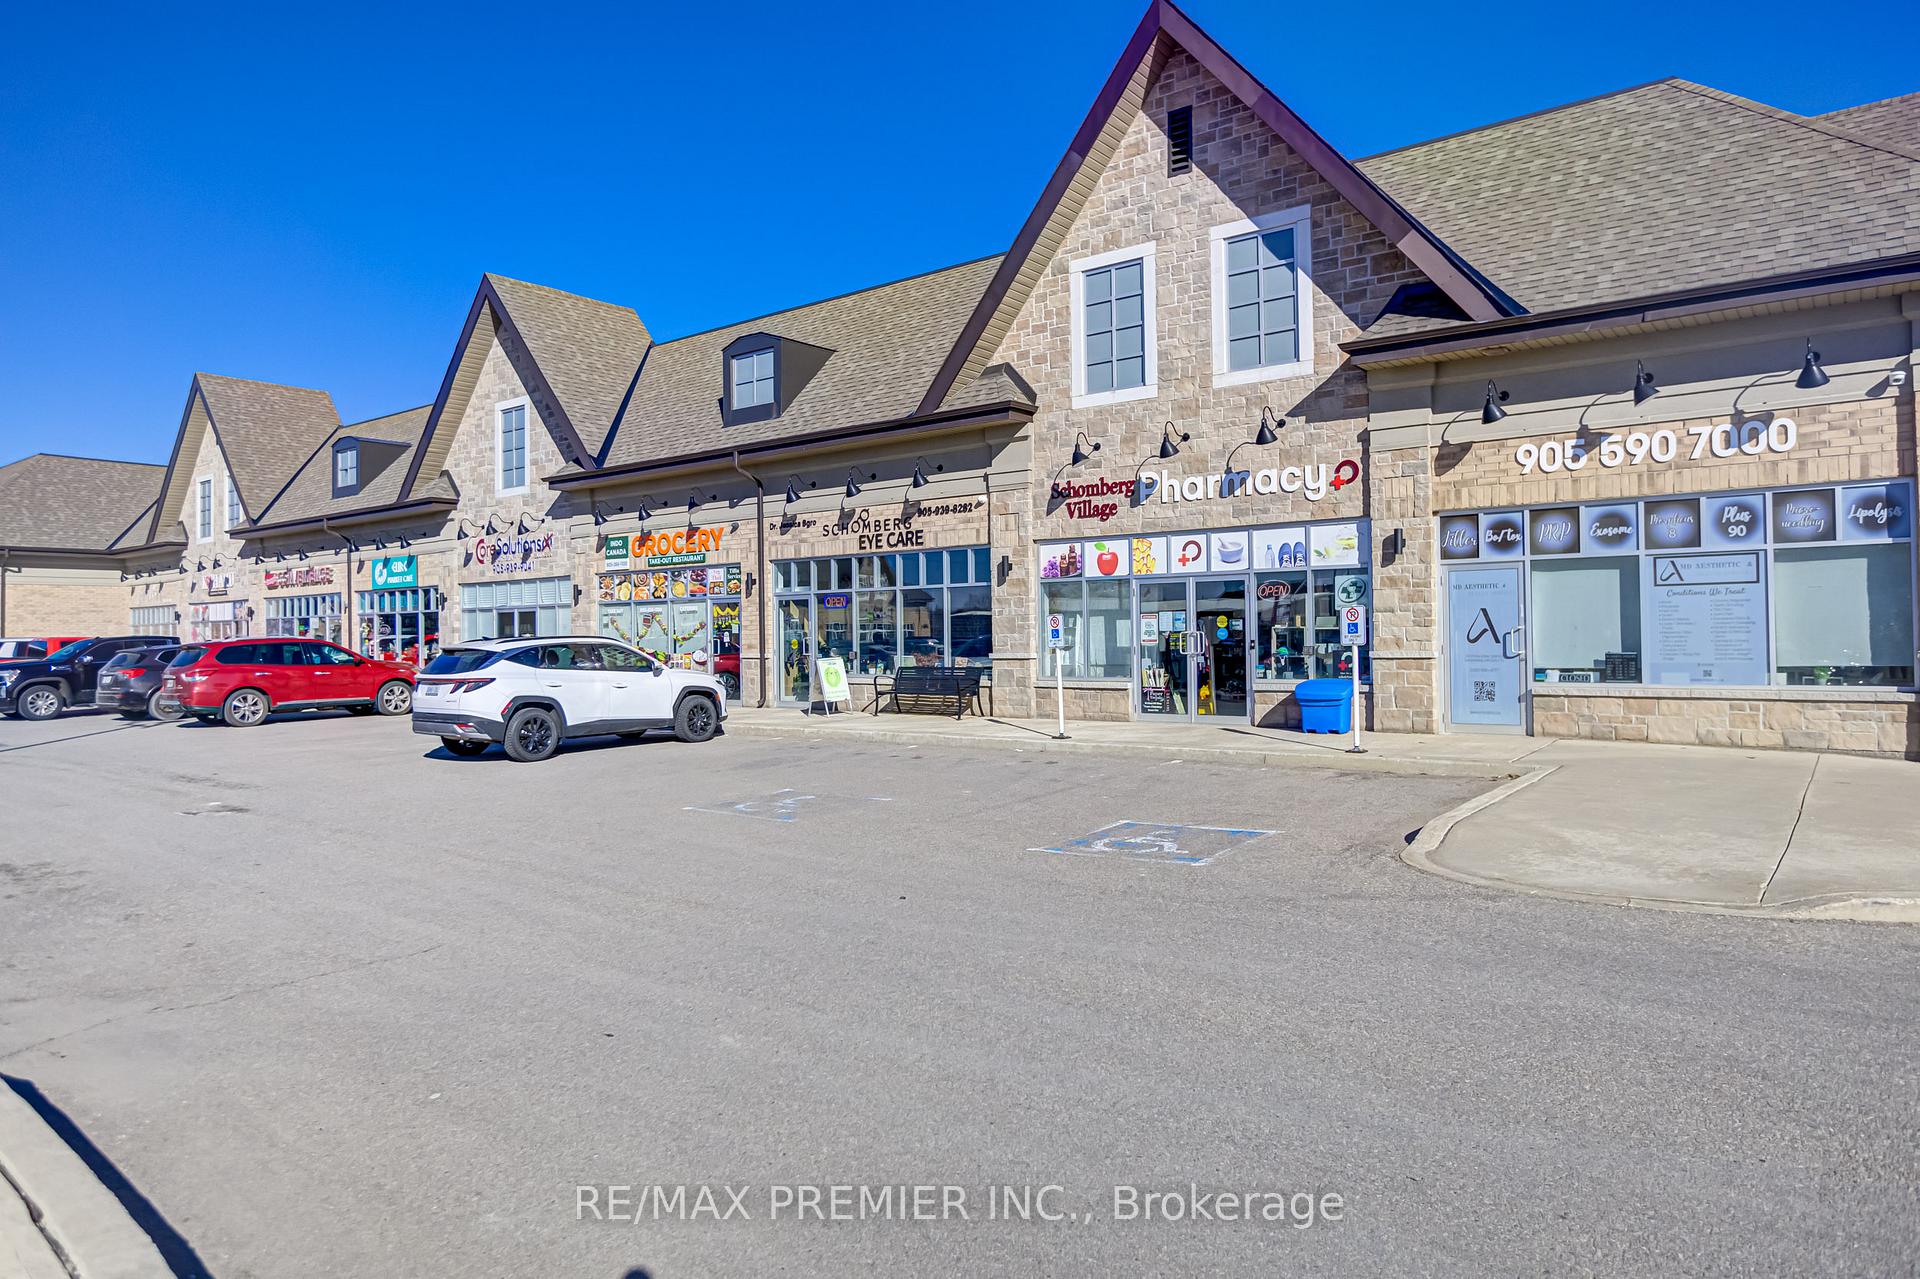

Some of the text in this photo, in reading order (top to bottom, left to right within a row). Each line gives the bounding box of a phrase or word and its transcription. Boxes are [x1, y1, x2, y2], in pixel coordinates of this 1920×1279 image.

[1515, 418, 1798, 475] 905 590 7000
[1051, 477, 1136, 501] Schomberg
[1139, 463, 1327, 505] Pharmacy
[917, 502, 973, 517] 905-939-8282
[1065, 499, 1118, 521] Village
[1721, 505, 1752, 523] Plus
[769, 522, 778, 530] Dr.
[822, 515, 912, 537] SCHOMBERG
[1539, 521, 1571, 543] PRP
[1590, 522, 1633, 537] Exosome
[1669, 527, 1676, 538] 8
[1728, 525, 1747, 537] 90
[631, 527, 724, 557] GROCERY
[859, 530, 924, 550] EYE CARE
[672, 555, 704, 563] RESTAURANT
[1695, 561, 1741, 569] AESTHETIC
[1260, 585, 1288, 597] OPEN
